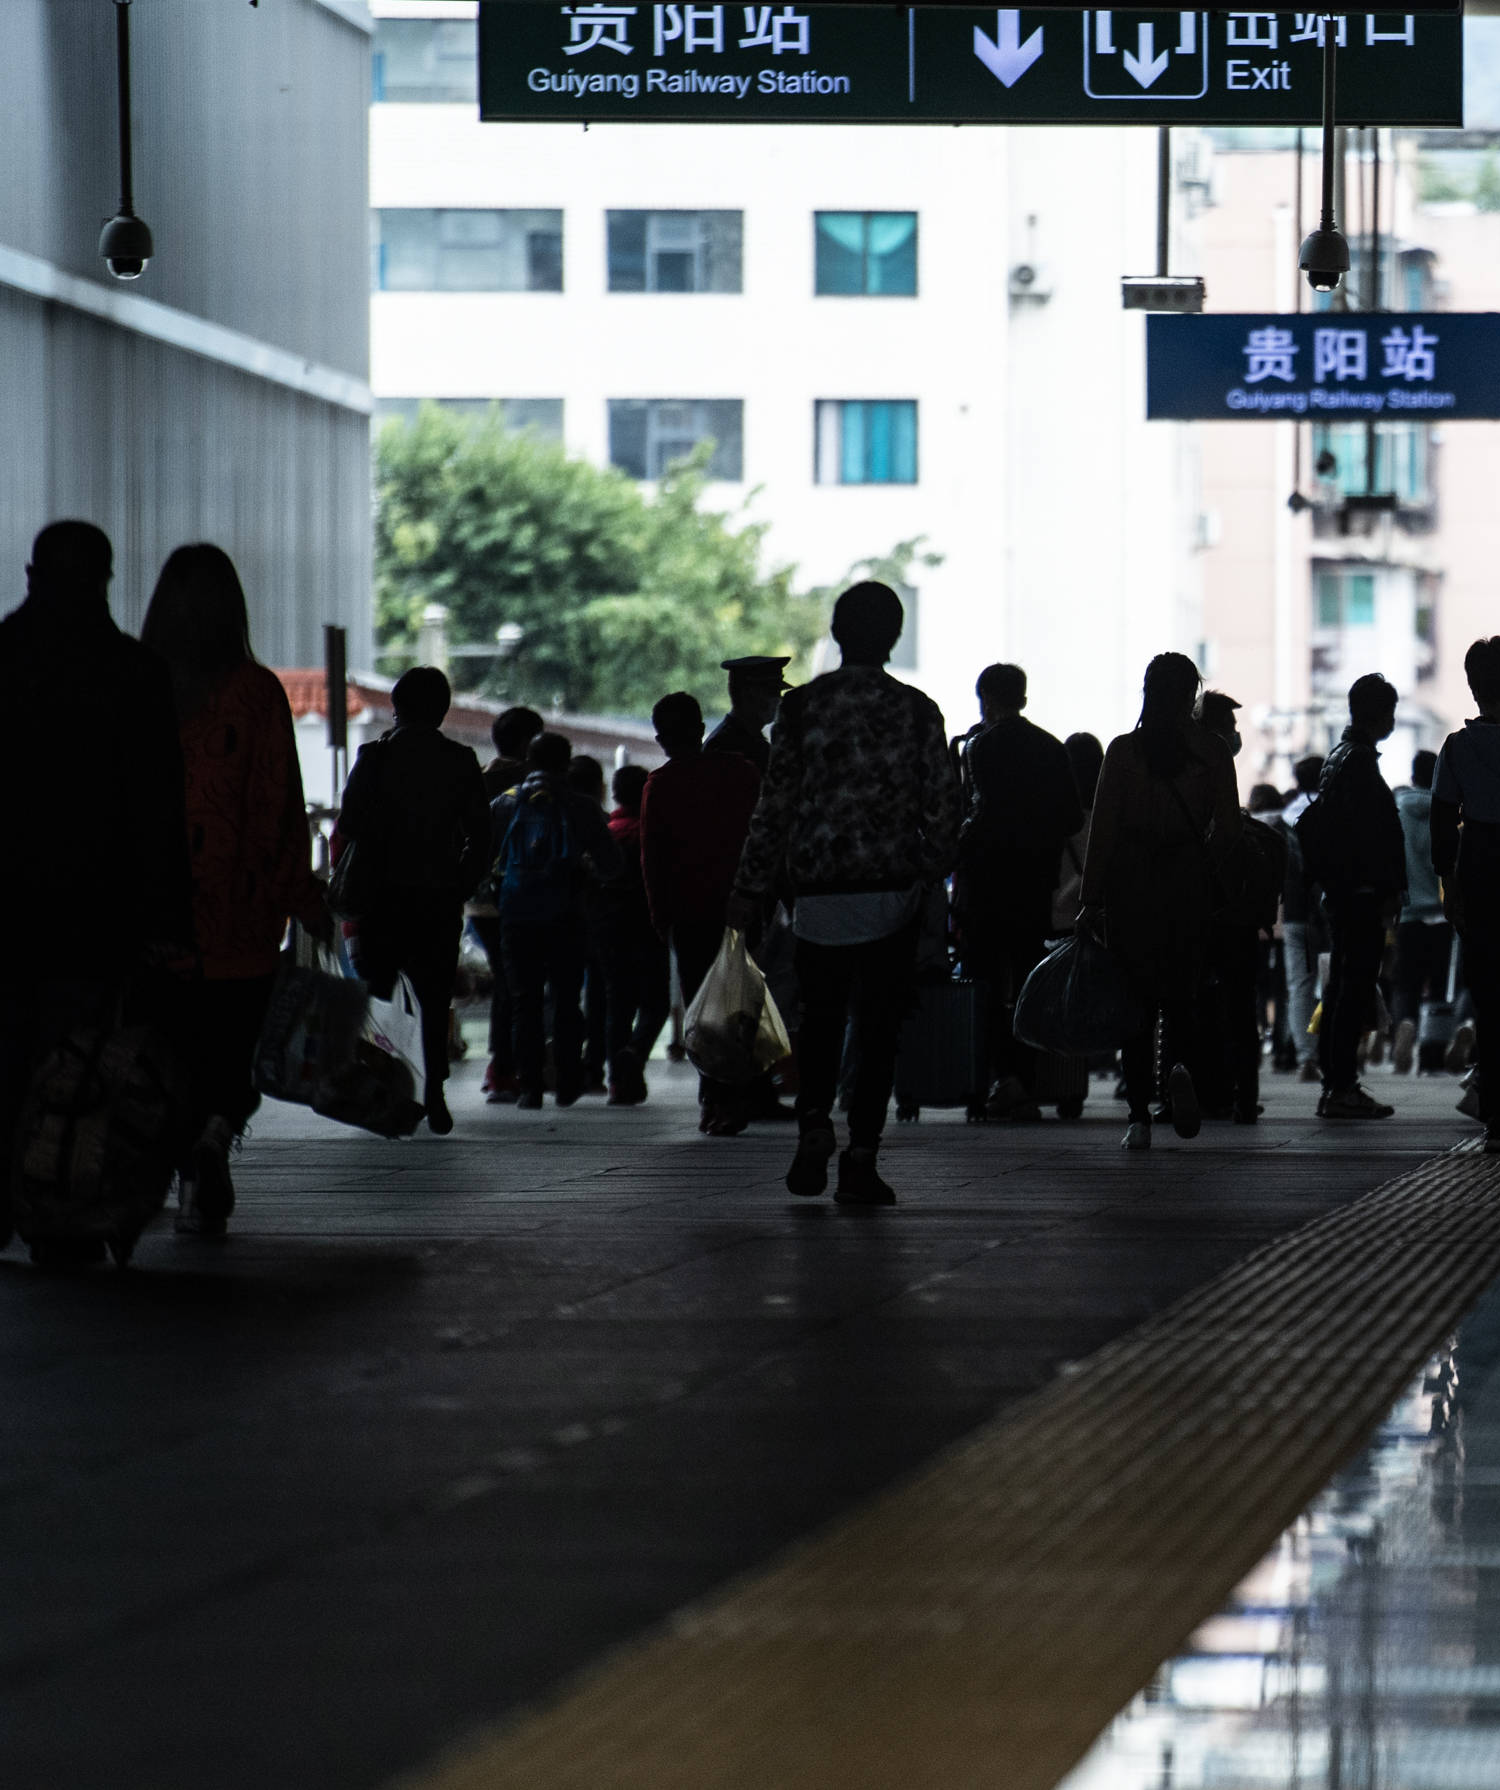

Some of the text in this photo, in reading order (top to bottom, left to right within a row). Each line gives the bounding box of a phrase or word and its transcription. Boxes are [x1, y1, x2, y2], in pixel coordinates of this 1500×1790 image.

[560, 3, 811, 56] 贵阳站
[527, 69, 850, 99] Guiyang Railway Station
[1227, 60, 1291, 91] Exit
[1242, 325, 1439, 383] 贵阳站
[1226, 388, 1456, 413] Guiyang Railway Station
